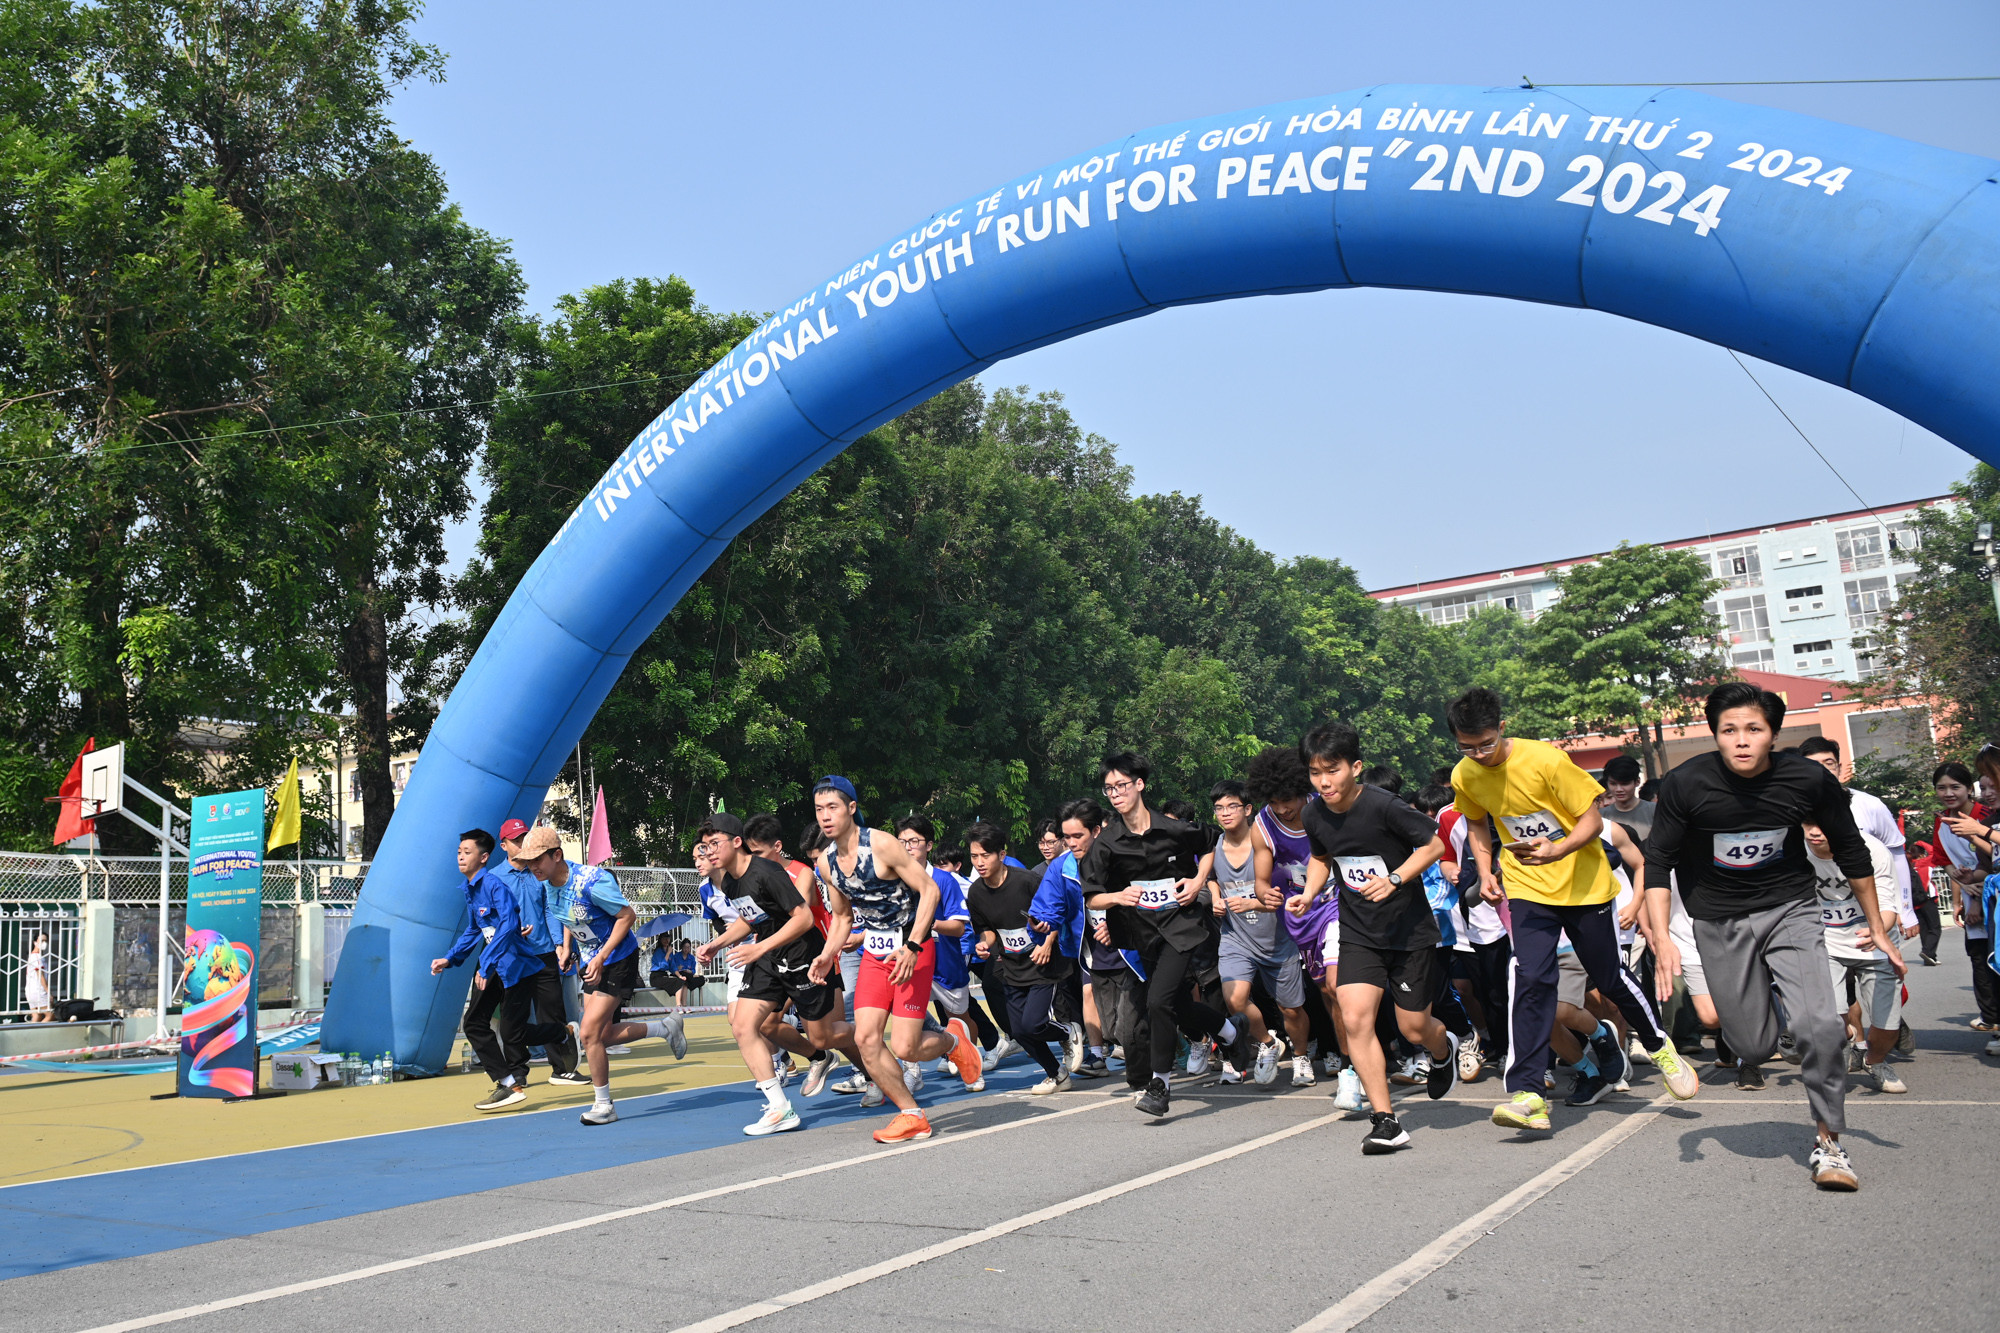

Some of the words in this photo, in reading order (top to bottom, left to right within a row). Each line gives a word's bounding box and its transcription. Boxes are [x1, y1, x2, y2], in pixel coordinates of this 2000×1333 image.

[744, 291, 817, 352] THANH
[825, 253, 880, 297] NIÊN
[888, 208, 963, 259] QUỐC
[976, 188, 1005, 216] TẾ
[1016, 174, 1043, 200] VÌ
[1053, 152, 1120, 188] MỘT
[1133, 130, 1190, 166] THẾ
[1198, 114, 1272, 151] GIỚI
[1376, 101, 1473, 134] BÌNH
[1482, 102, 1569, 139] LẦN
[1585, 117, 1680, 150] THỨ
[1677, 131, 1713, 159] 2
[1727, 143, 1853, 196] 2024
[594, 306, 839, 522] INTERNATIONAL
[845, 231, 974, 320] YOUTH
[1106, 164, 1198, 221] FOR
[1556, 155, 1731, 237] 2024
[1515, 822, 1549, 838] 264
[194, 850, 236, 865] INTERNATIONAL
[237, 850, 257, 859] YOUTH
[1727, 843, 1774, 860] 495
[209, 860, 225, 871] FOR
[215, 868, 234, 880] 2024
[1142, 890, 1169, 903] 335
[738, 905, 757, 917] 212
[1823, 908, 1858, 920] 512
[869, 936, 895, 950] 334
[1005, 937, 1026, 948] 028
